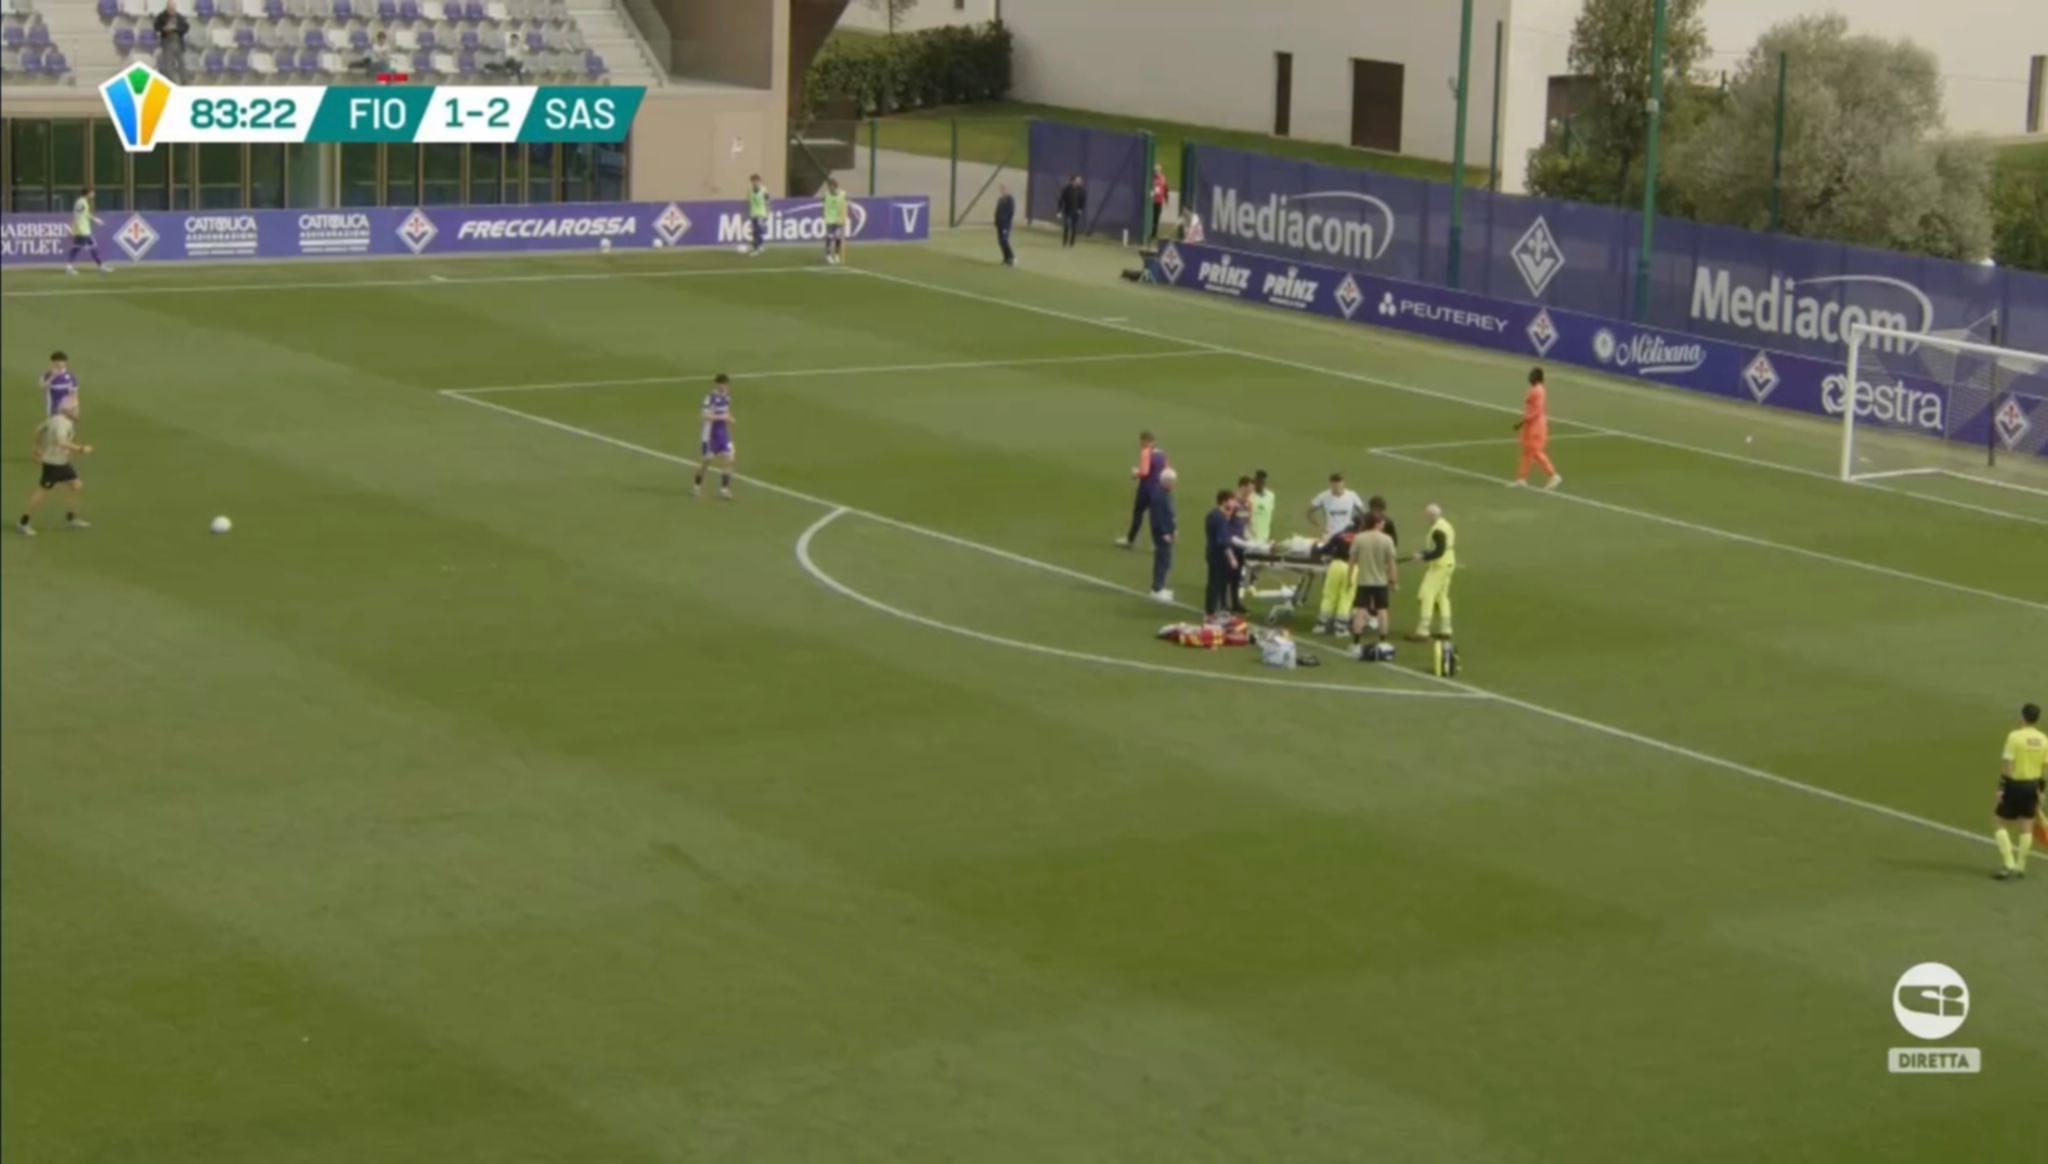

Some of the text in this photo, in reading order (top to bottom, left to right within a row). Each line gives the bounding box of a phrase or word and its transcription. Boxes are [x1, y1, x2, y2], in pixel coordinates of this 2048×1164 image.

[457, 216, 637, 240] FRECCIAROSSA
[1210, 184, 1374, 260] Mediacom
[1400, 300, 1509, 333] PEUTEREY
[1691, 265, 1907, 353] Mediacom
[1852, 380, 1943, 430] estra
